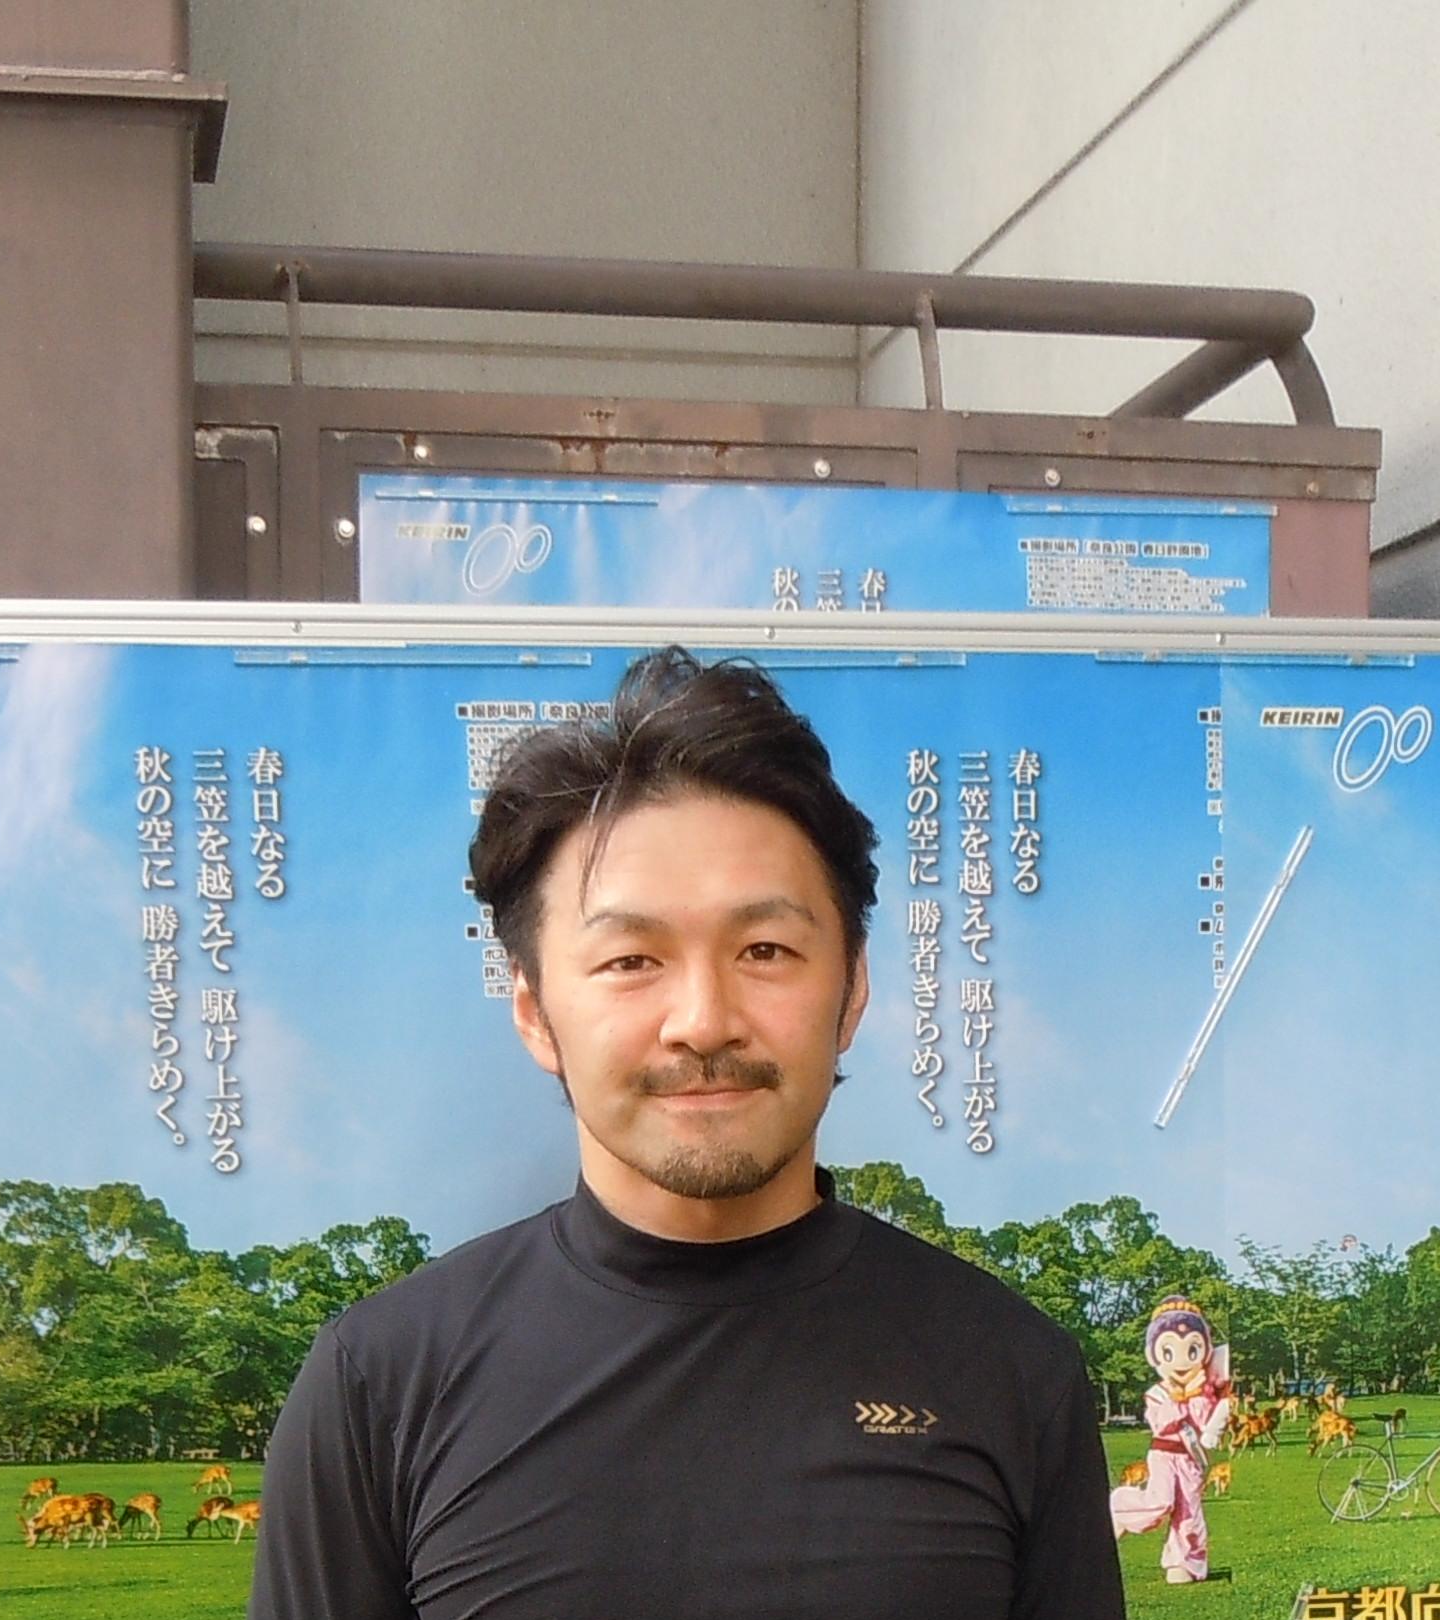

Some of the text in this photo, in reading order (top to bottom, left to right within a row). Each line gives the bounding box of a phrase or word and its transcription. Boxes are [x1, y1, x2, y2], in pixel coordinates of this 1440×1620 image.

[247, 746, 286, 899] 春日なる
[1008, 747, 1041, 894] 春日なる
[1262, 709, 1342, 727] KEIRIN
[134, 746, 186, 1146] 秋の空に 勝者きらめく。
[192, 747, 244, 1173] 三笠を越えて 駆け上がる
[906, 749, 945, 1127] 秋の空に 勝者きらめく。
[958, 750, 996, 1153] 三笠を越えて 駆け上がる
